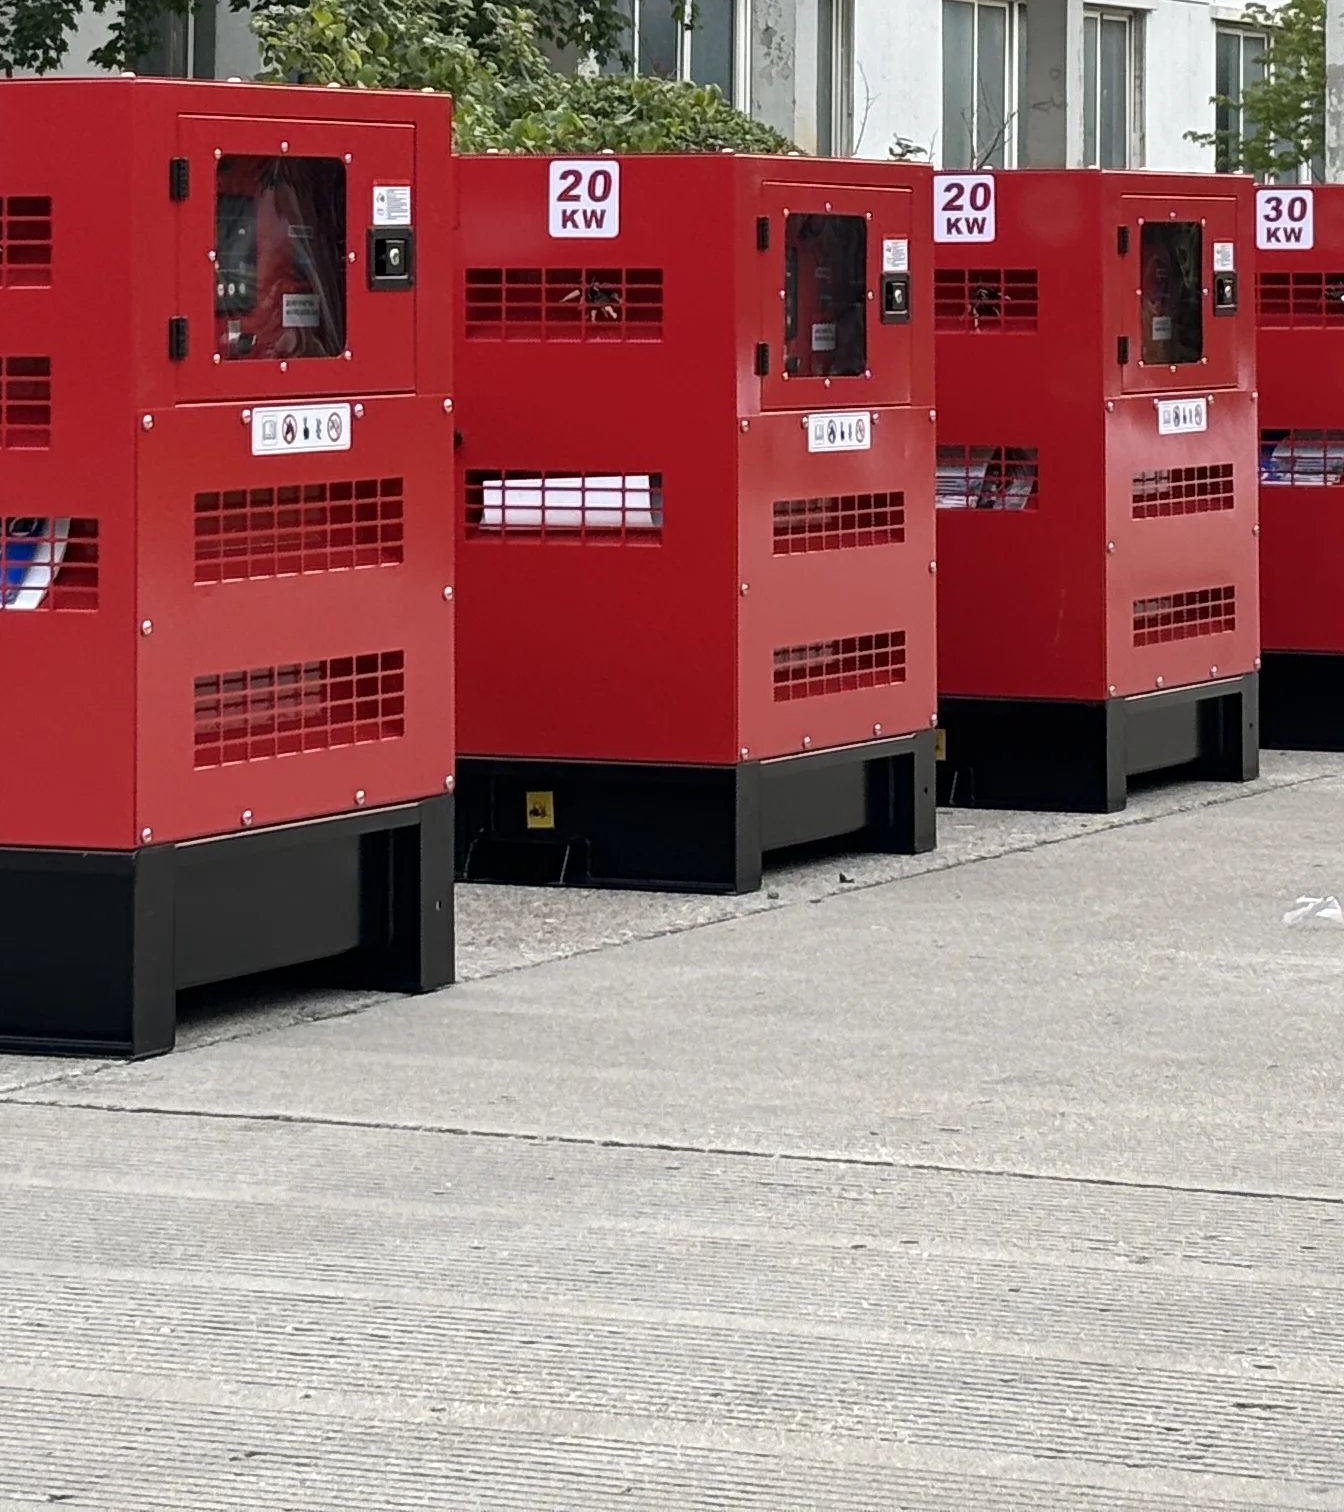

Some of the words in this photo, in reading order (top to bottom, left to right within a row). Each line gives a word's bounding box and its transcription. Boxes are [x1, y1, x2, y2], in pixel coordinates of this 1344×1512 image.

[556, 169, 612, 203] 20
[941, 182, 992, 212] 20
[561, 208, 607, 229] KW
[1263, 196, 1308, 222] 30
[946, 216, 987, 235] KW
[1266, 226, 1304, 243] KW
